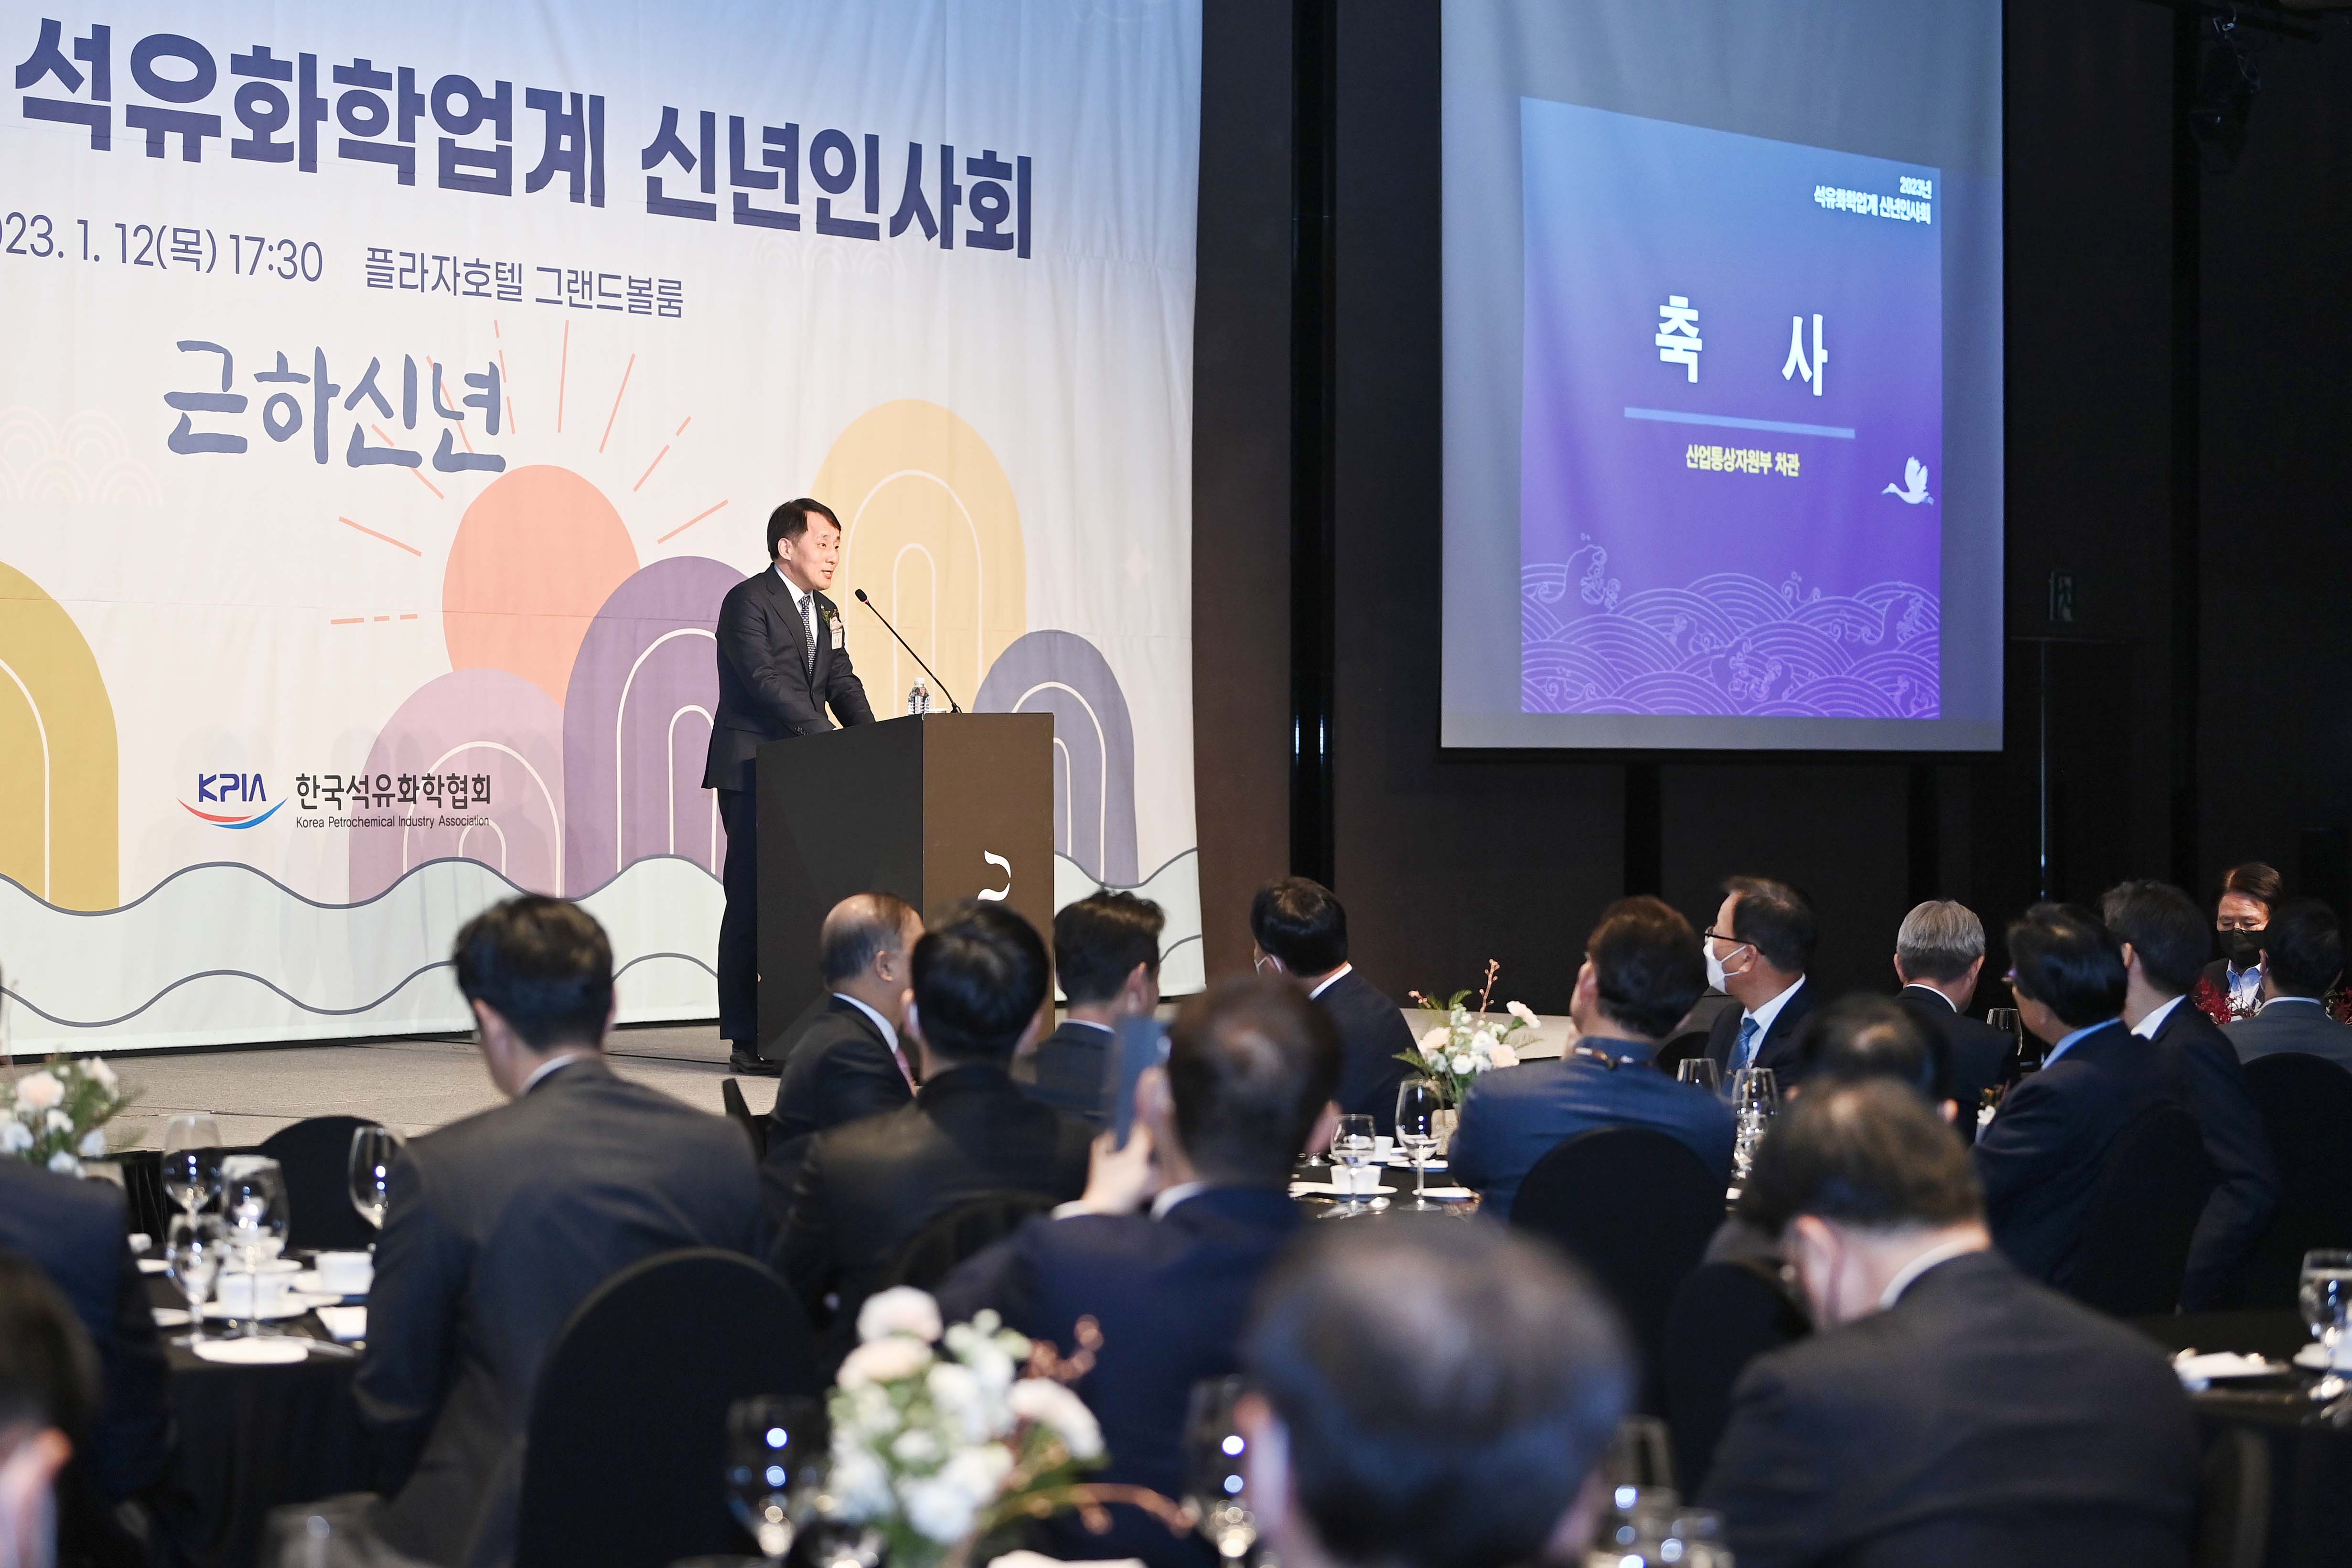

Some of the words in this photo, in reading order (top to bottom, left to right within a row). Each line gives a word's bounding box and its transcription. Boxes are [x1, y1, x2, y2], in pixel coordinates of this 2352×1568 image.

[16, 18, 605, 208] 석유화학업계
[642, 106, 1031, 259] 신년인사회
[1814, 185, 1878, 216] 석유화학업계
[1879, 196, 1931, 225] 신년인사회
[1899, 176, 1932, 199] 2023년
[0, 212, 64, 258] 23.
[115, 222, 217, 273] 12(목)
[229, 234, 323, 282] 17:30
[365, 246, 523, 302] 플라자호텔
[535, 266, 684, 319] 그랜드볼룸
[163, 340, 506, 473] 근하신년
[1686, 444, 1773, 475] 산업통상자원부
[1774, 452, 1801, 477] 차관
[198, 773, 267, 803] KPIA
[296, 773, 490, 811] 한국석유화학협회
[296, 816, 324, 828] Korea
[329, 815, 395, 827] Petrochemical
[398, 815, 434, 829] Industry
[438, 815, 489, 827] Association
